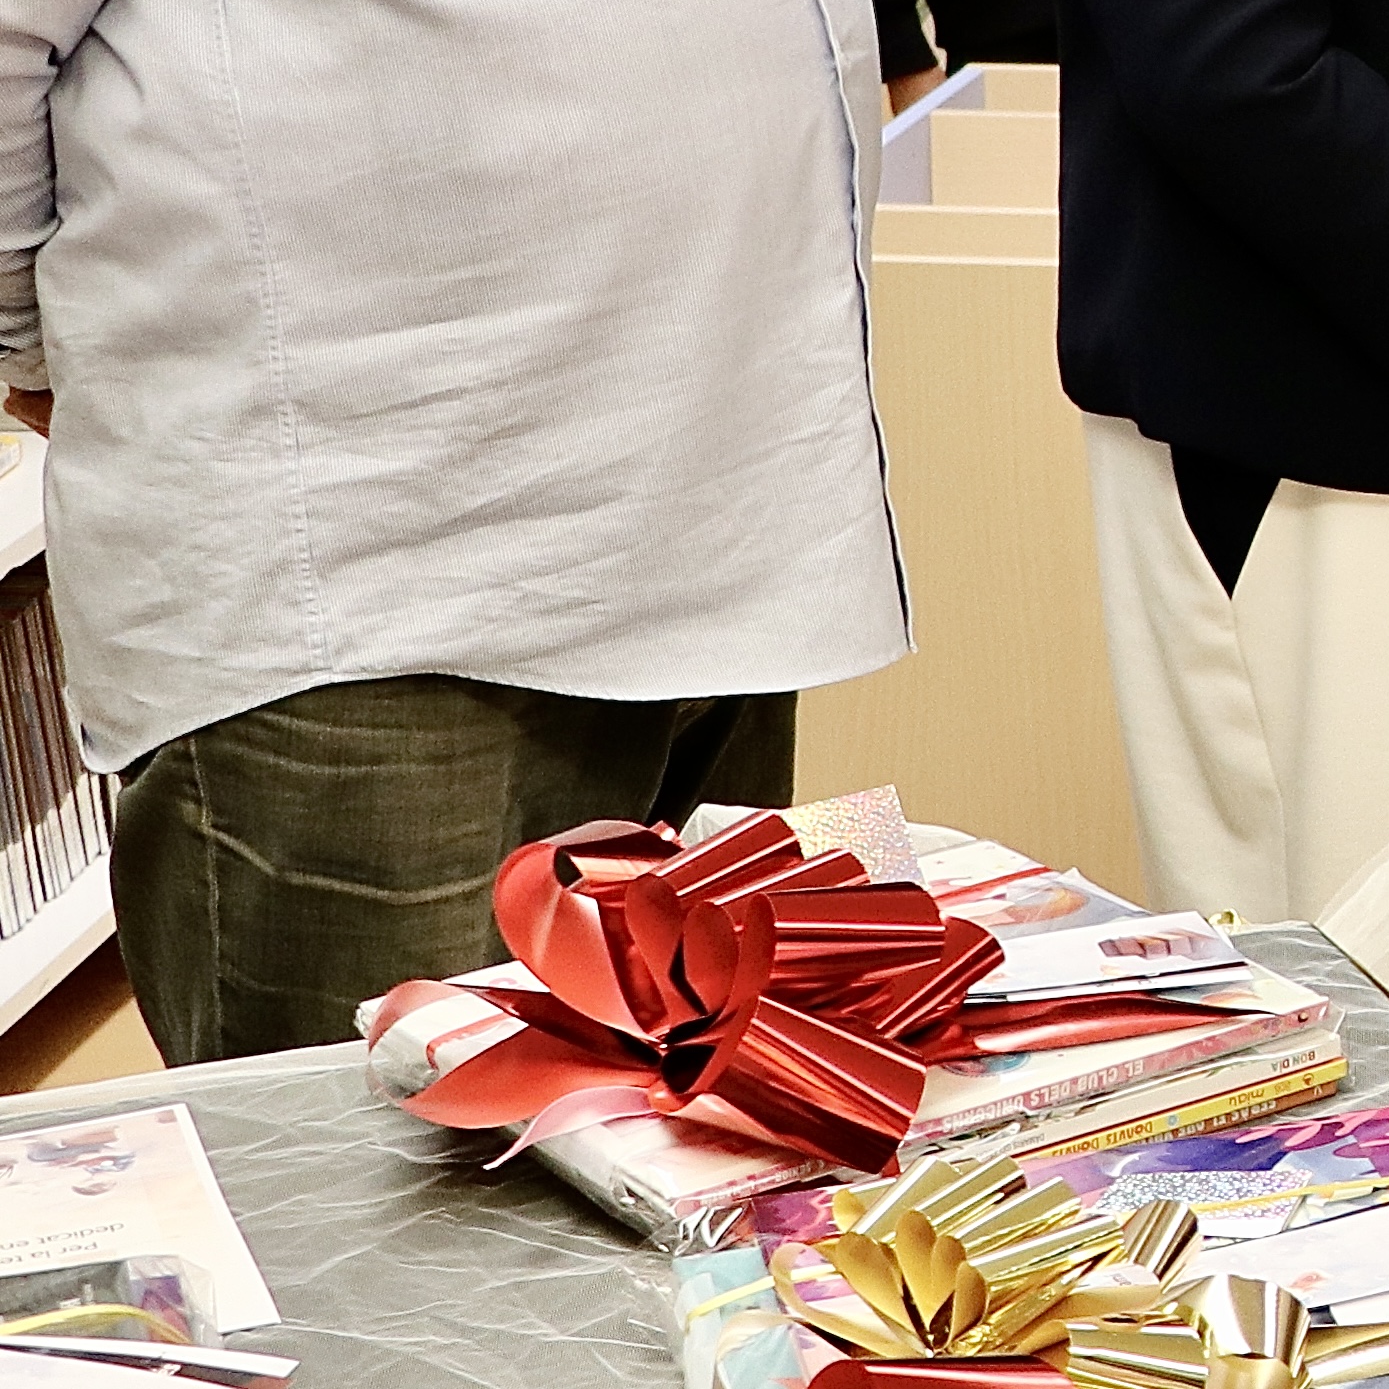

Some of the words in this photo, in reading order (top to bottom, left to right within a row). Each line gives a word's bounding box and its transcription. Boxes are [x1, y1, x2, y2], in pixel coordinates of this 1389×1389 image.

[1292, 1050, 1316, 1066] BON
[1127, 1060, 1144, 1077] EL
[1077, 1069, 1119, 1092] CLUB
[1030, 1080, 1070, 1105] DELS
[37, 1222, 125, 1244] dedicat
[60, 1241, 98, 1254] Per
[0, 1255, 22, 1264] te
